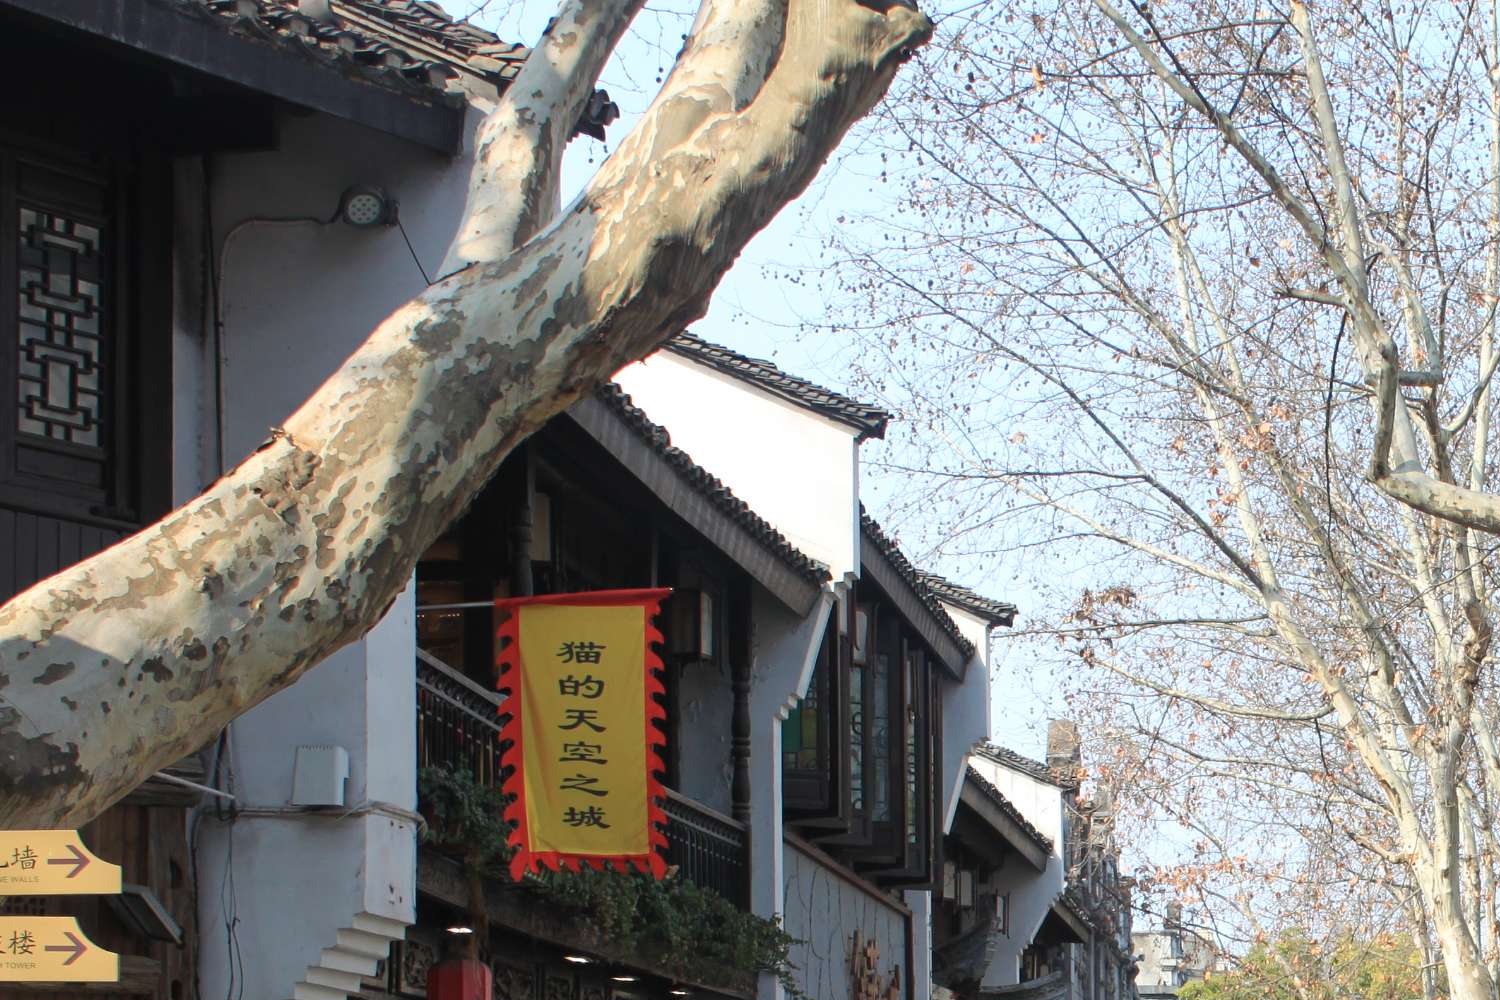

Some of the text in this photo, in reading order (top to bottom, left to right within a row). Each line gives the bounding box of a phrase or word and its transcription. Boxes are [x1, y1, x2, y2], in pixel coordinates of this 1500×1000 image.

[556, 641, 611, 829] 猫的天空之城
